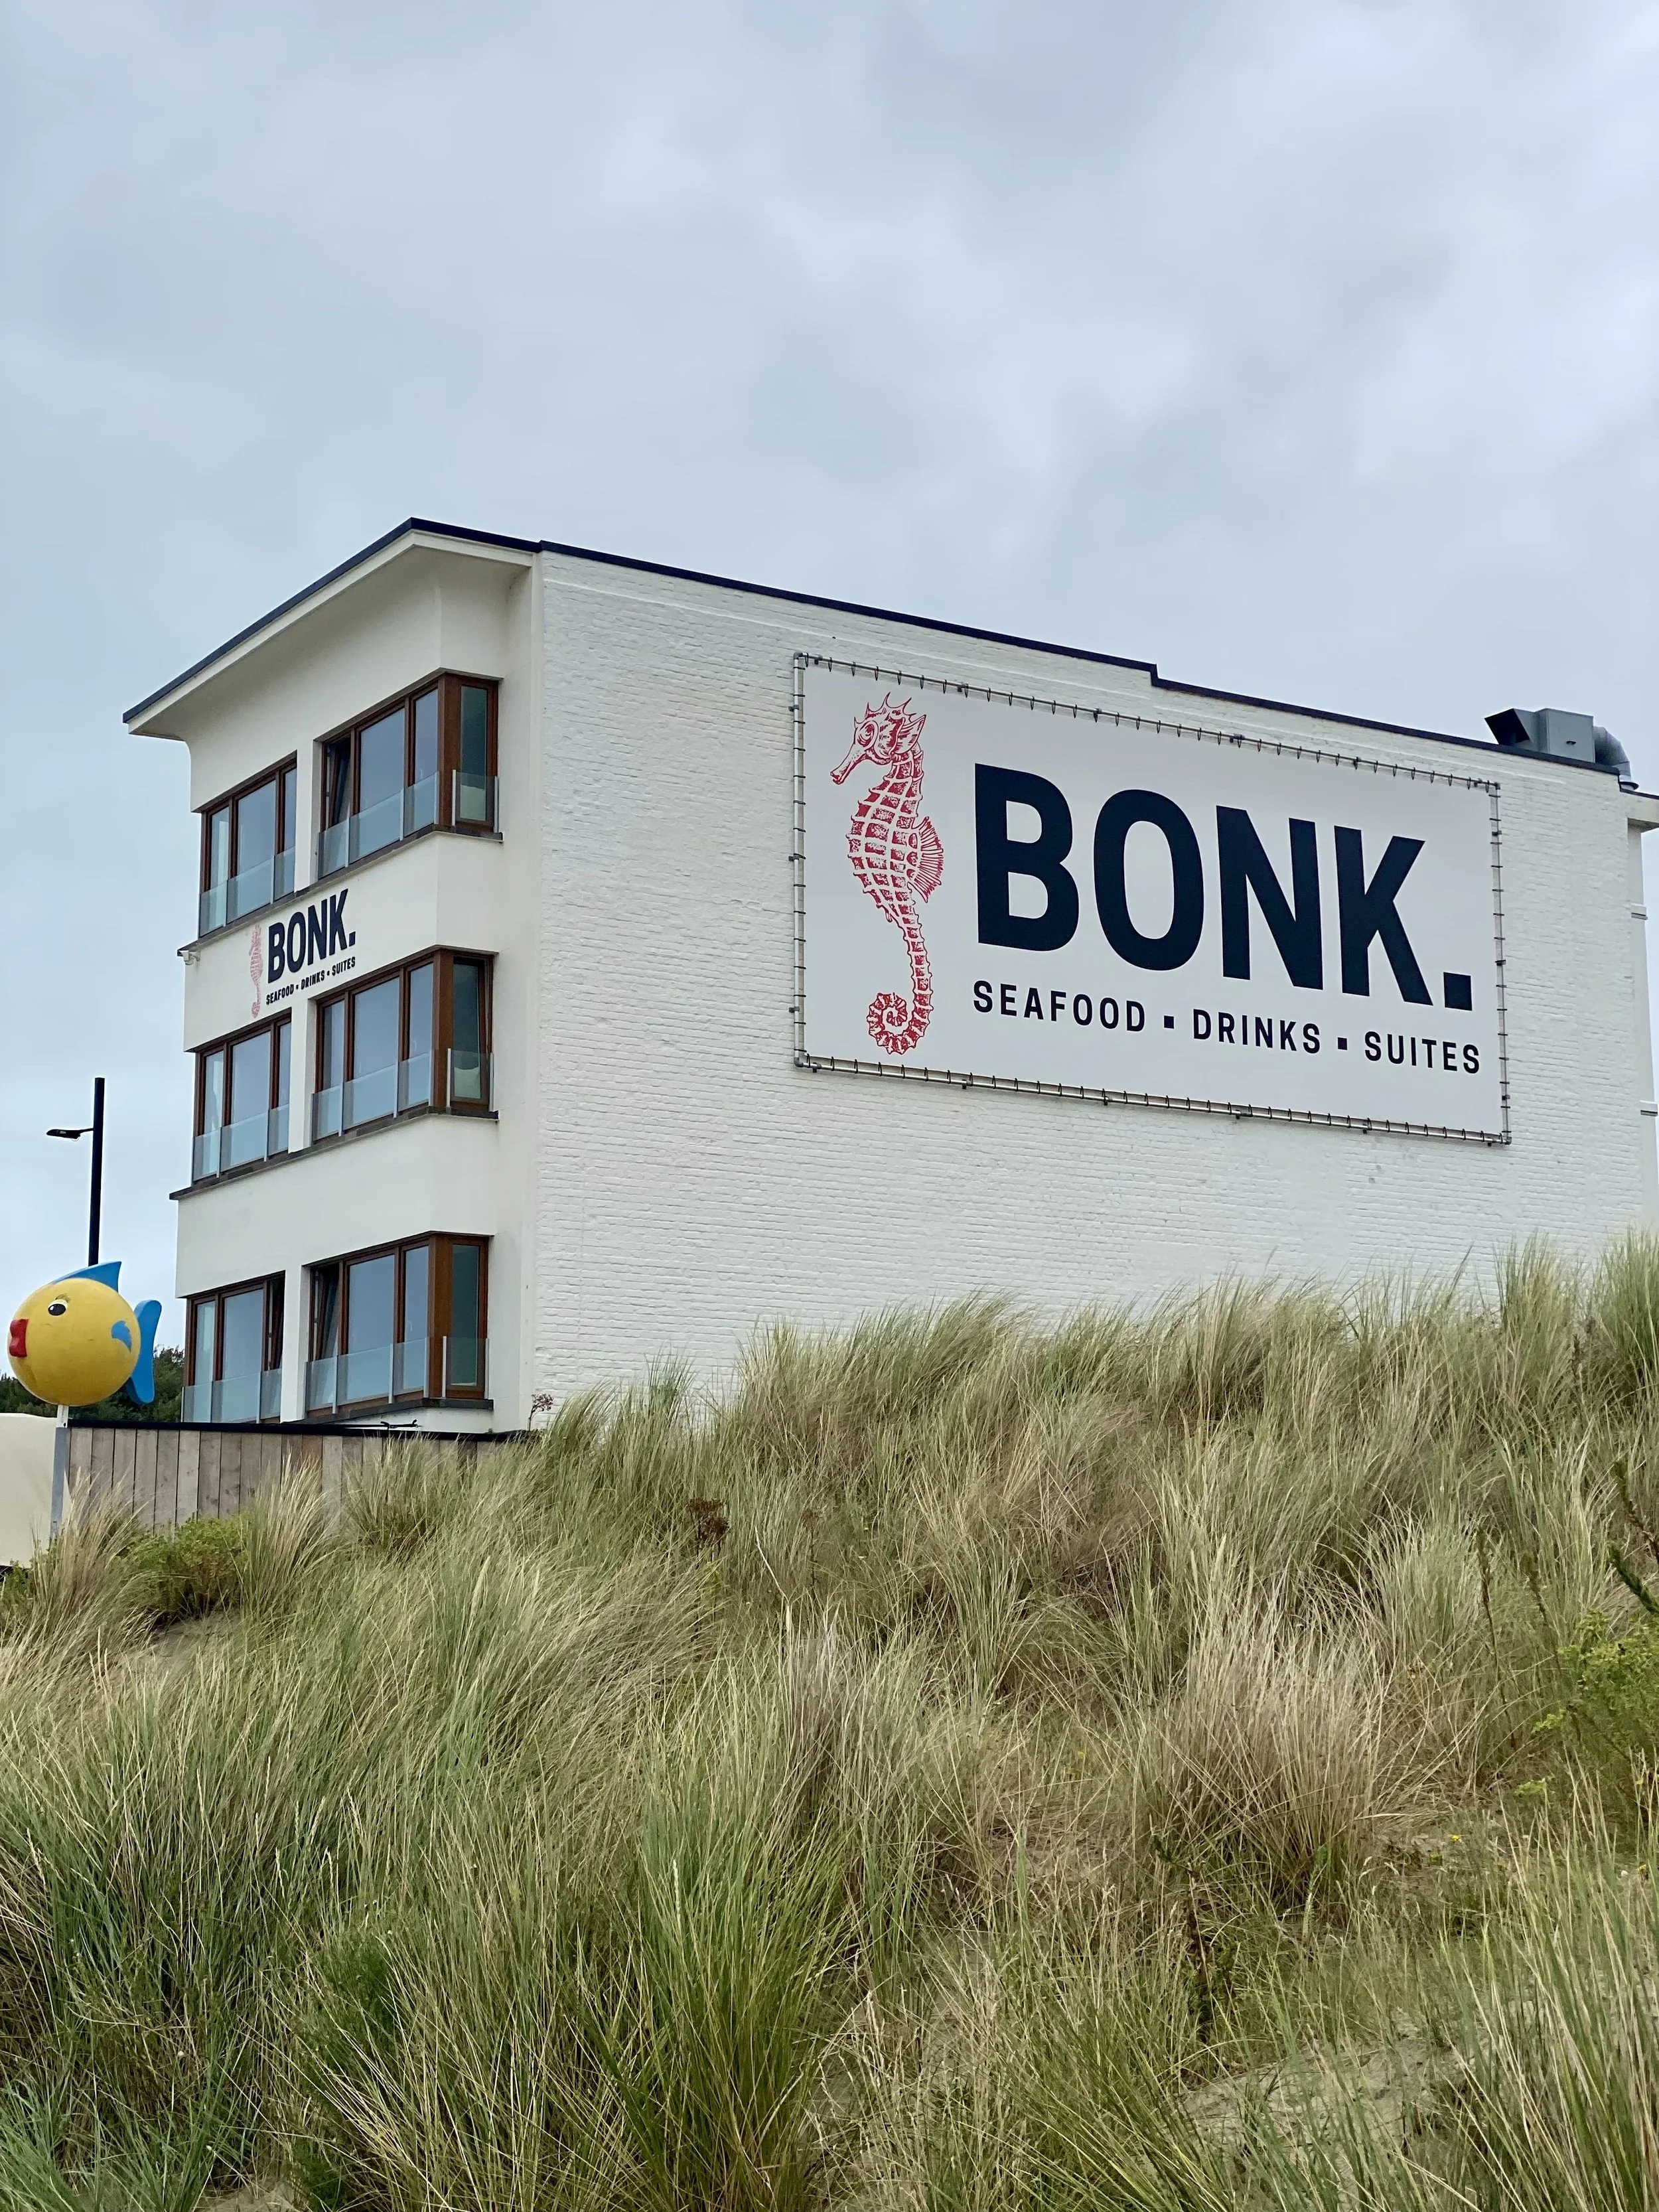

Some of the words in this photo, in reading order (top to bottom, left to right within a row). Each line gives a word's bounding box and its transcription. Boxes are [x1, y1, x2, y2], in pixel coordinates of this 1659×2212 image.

[974, 763, 1473, 1011] BONK.
[265, 984, 295, 1005] SEAFOOD
[301, 970, 325, 990] DRINKS
[331, 956, 356, 976] SUITES
[267, 888, 356, 984] BONK.
[973, 980, 1146, 1033] SEAFOOD
[1192, 1008, 1321, 1055] DRINKS
[1364, 1030, 1480, 1074] SUITES
